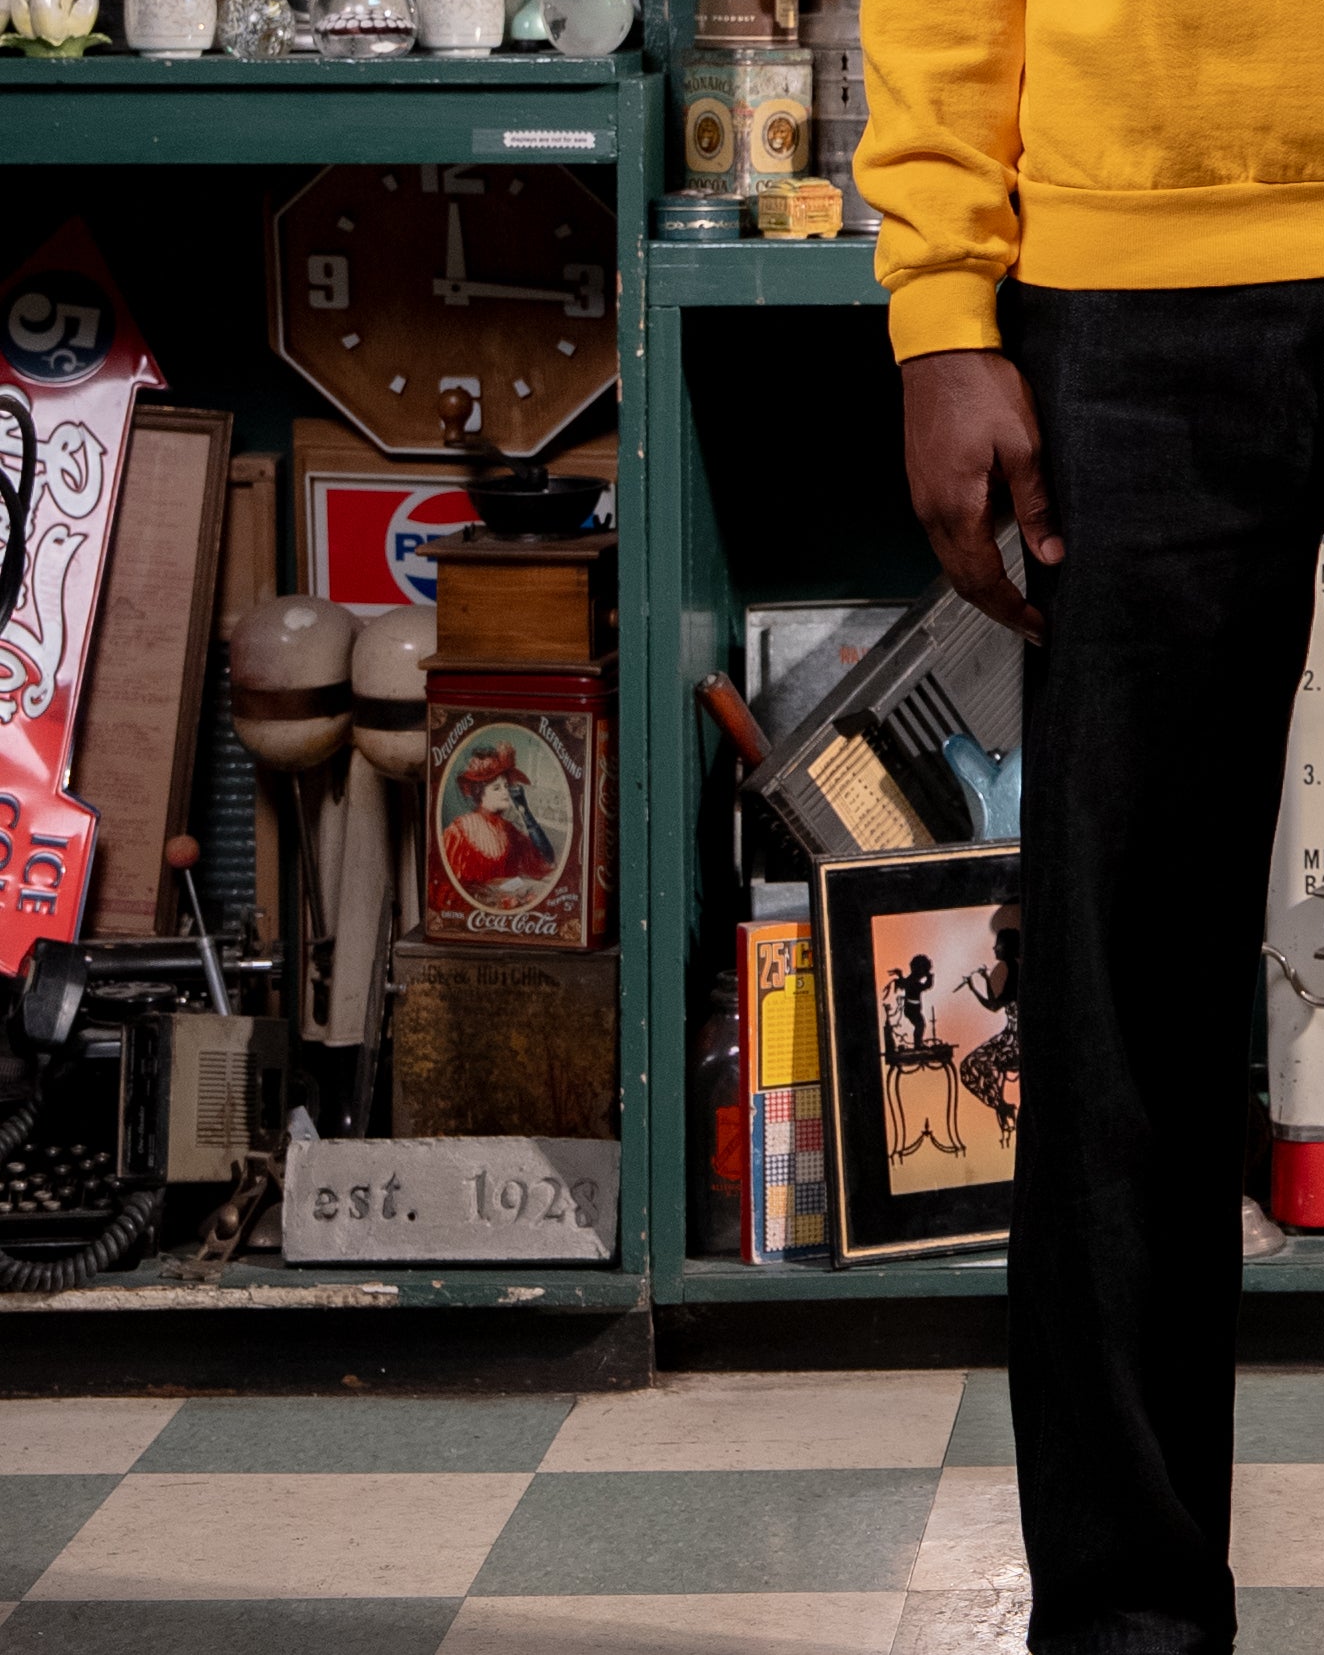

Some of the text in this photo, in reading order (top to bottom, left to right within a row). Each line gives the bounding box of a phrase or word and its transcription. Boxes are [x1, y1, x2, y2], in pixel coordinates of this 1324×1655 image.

[687, 176, 729, 193] COCOA
[308, 255, 350, 310] 9
[563, 263, 605, 318] 3
[1303, 670, 1321, 691] 2.
[431, 712, 476, 768] DELICIOUS
[538, 715, 583, 780] REFRESHING
[1304, 764, 1322, 786] 3.
[16, 833, 69, 915] ICE
[466, 908, 560, 935] Coca-Cola
[312, 1168, 600, 1230] est. 1928
